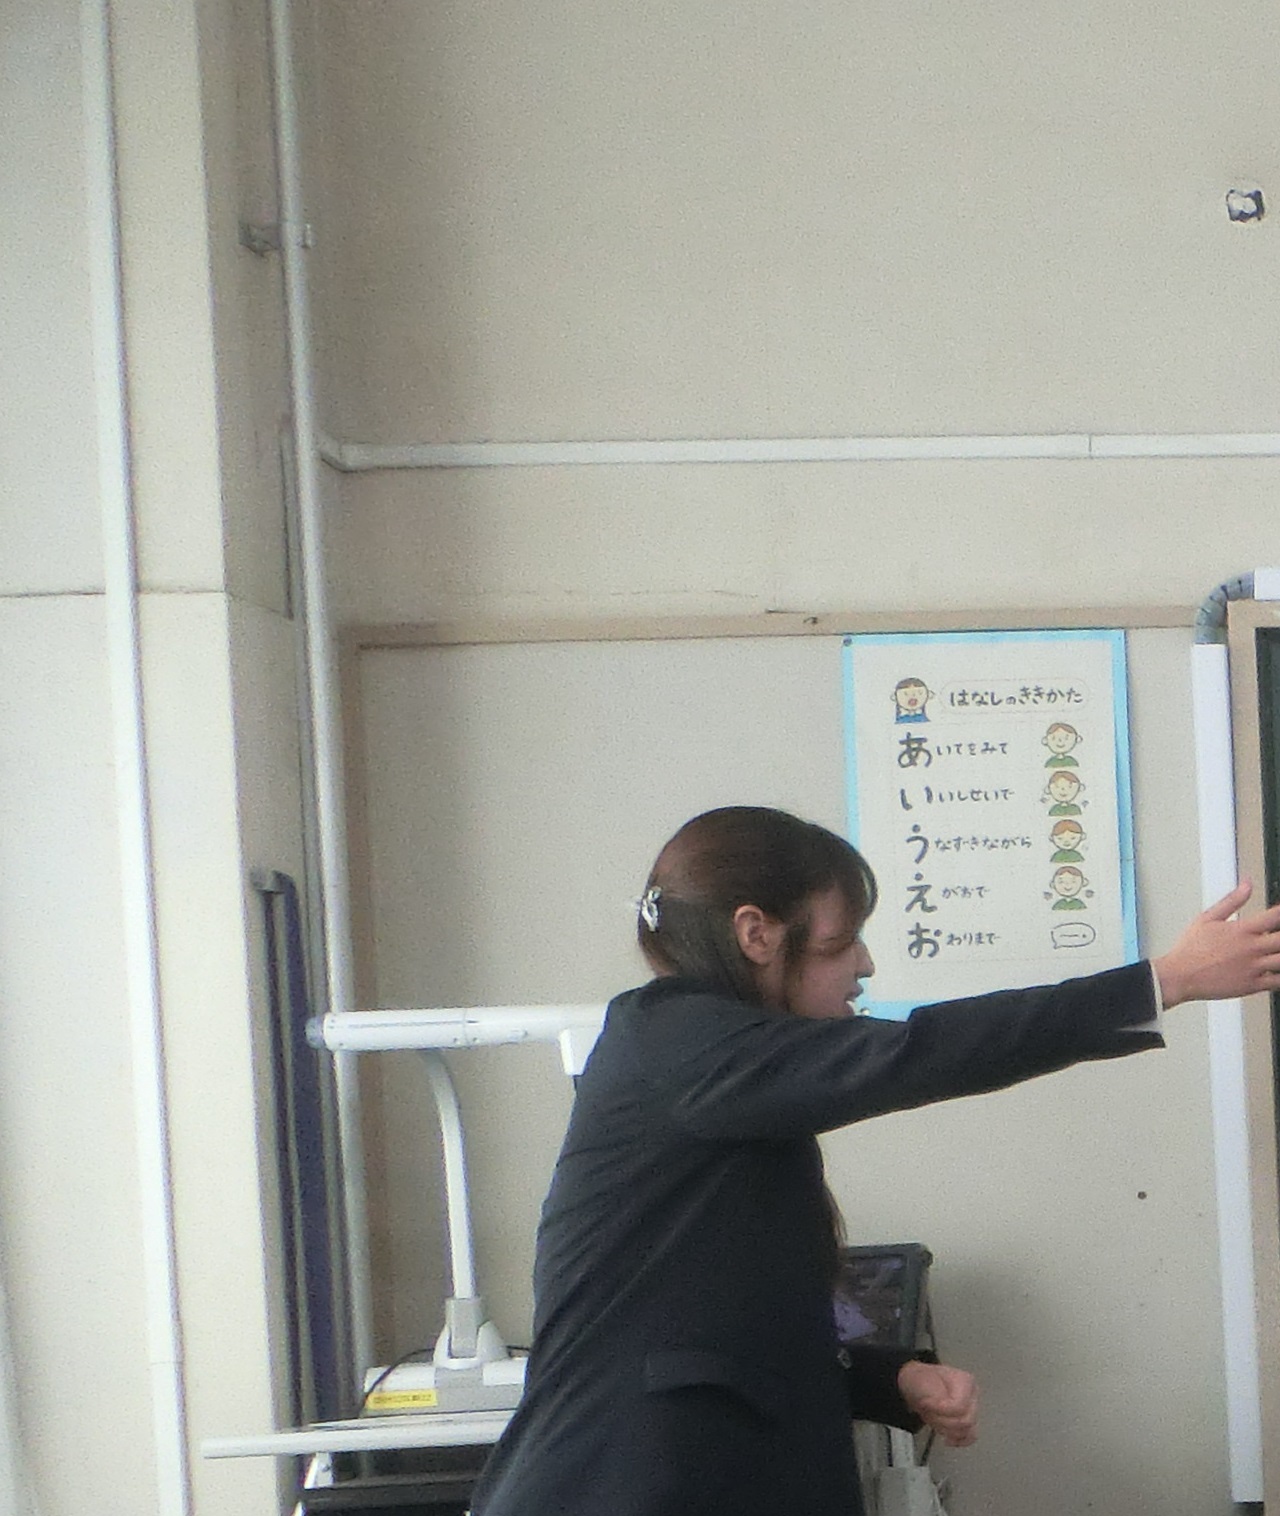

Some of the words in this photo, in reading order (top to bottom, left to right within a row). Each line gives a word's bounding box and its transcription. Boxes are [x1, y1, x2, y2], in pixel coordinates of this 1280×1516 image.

[949, 685, 1084, 706] はなしのききかた
[904, 872, 991, 913] えがおで
[907, 921, 1001, 959] おわりまで
